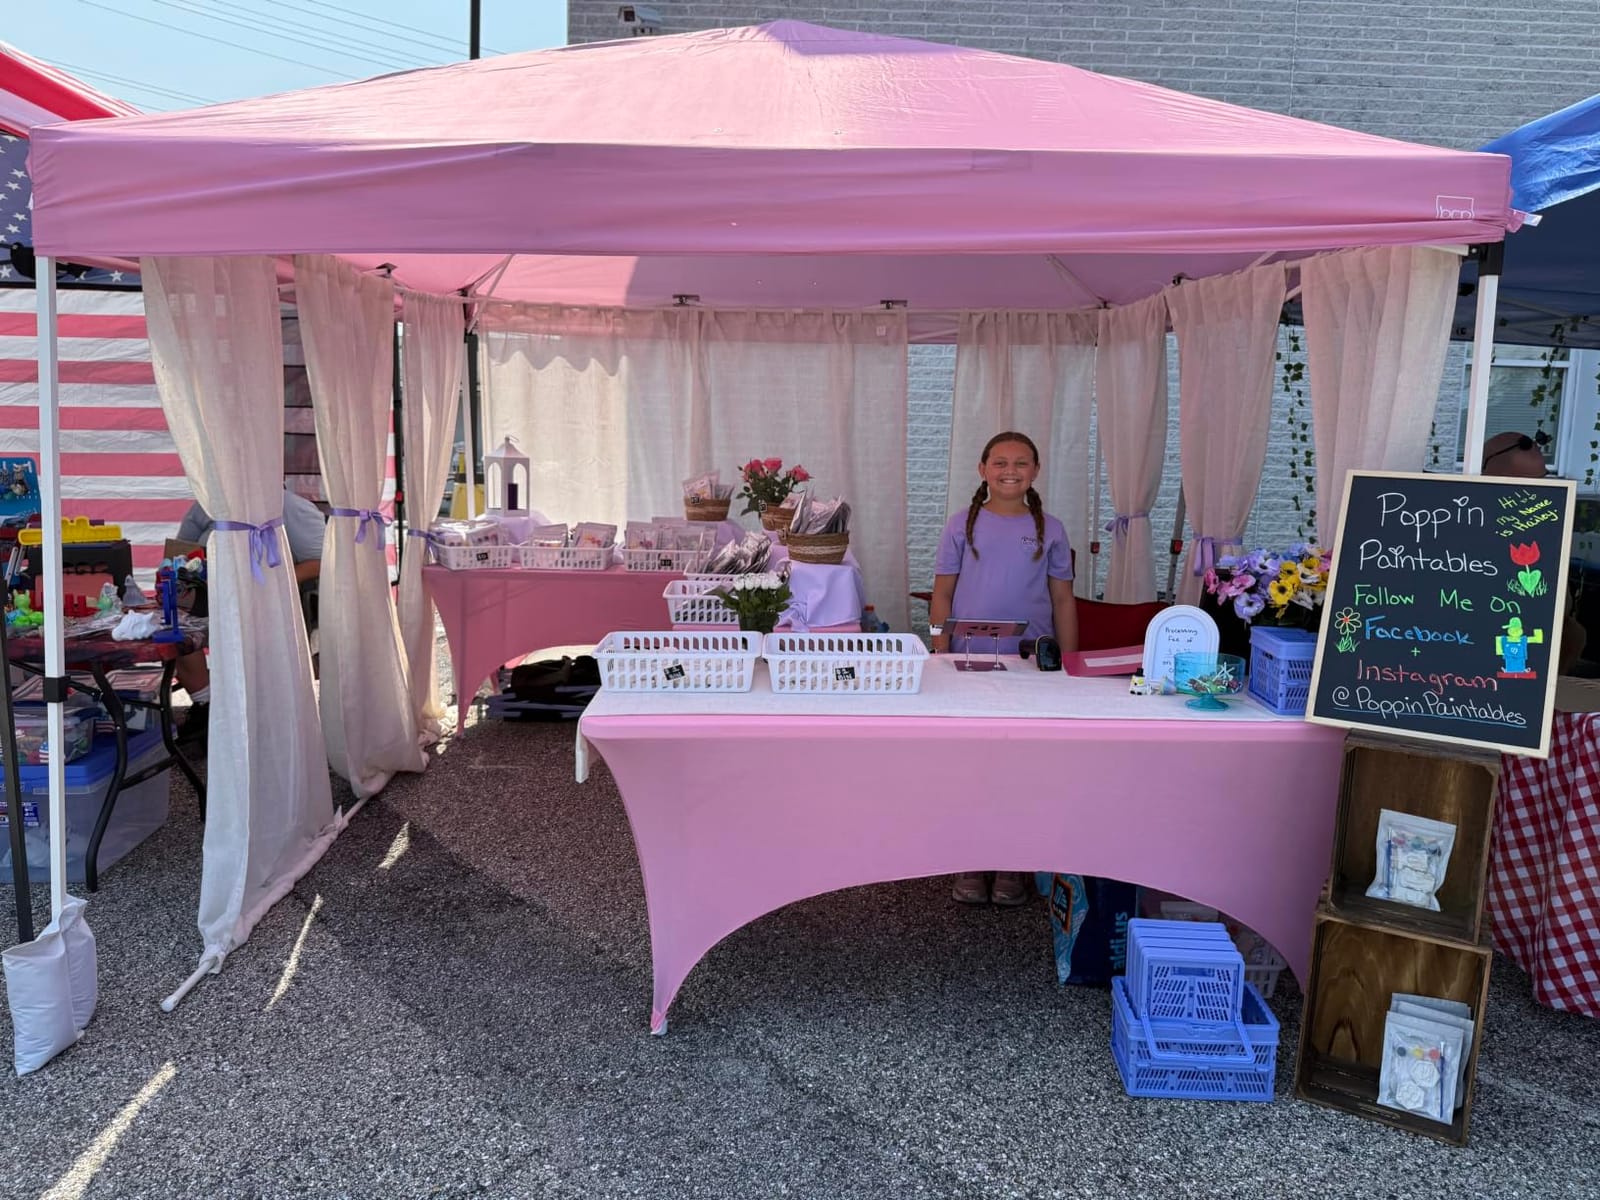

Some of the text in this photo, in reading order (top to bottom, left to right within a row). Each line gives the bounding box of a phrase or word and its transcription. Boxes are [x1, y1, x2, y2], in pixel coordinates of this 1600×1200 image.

[1376, 492, 1484, 542] Poppin
[1359, 538, 1498, 576] Paintables
[1354, 584, 1415, 606] Follow
[1440, 588, 1474, 611] Me
[1365, 615, 1475, 645] Facebook
[1356, 659, 1498, 695] Instagram
